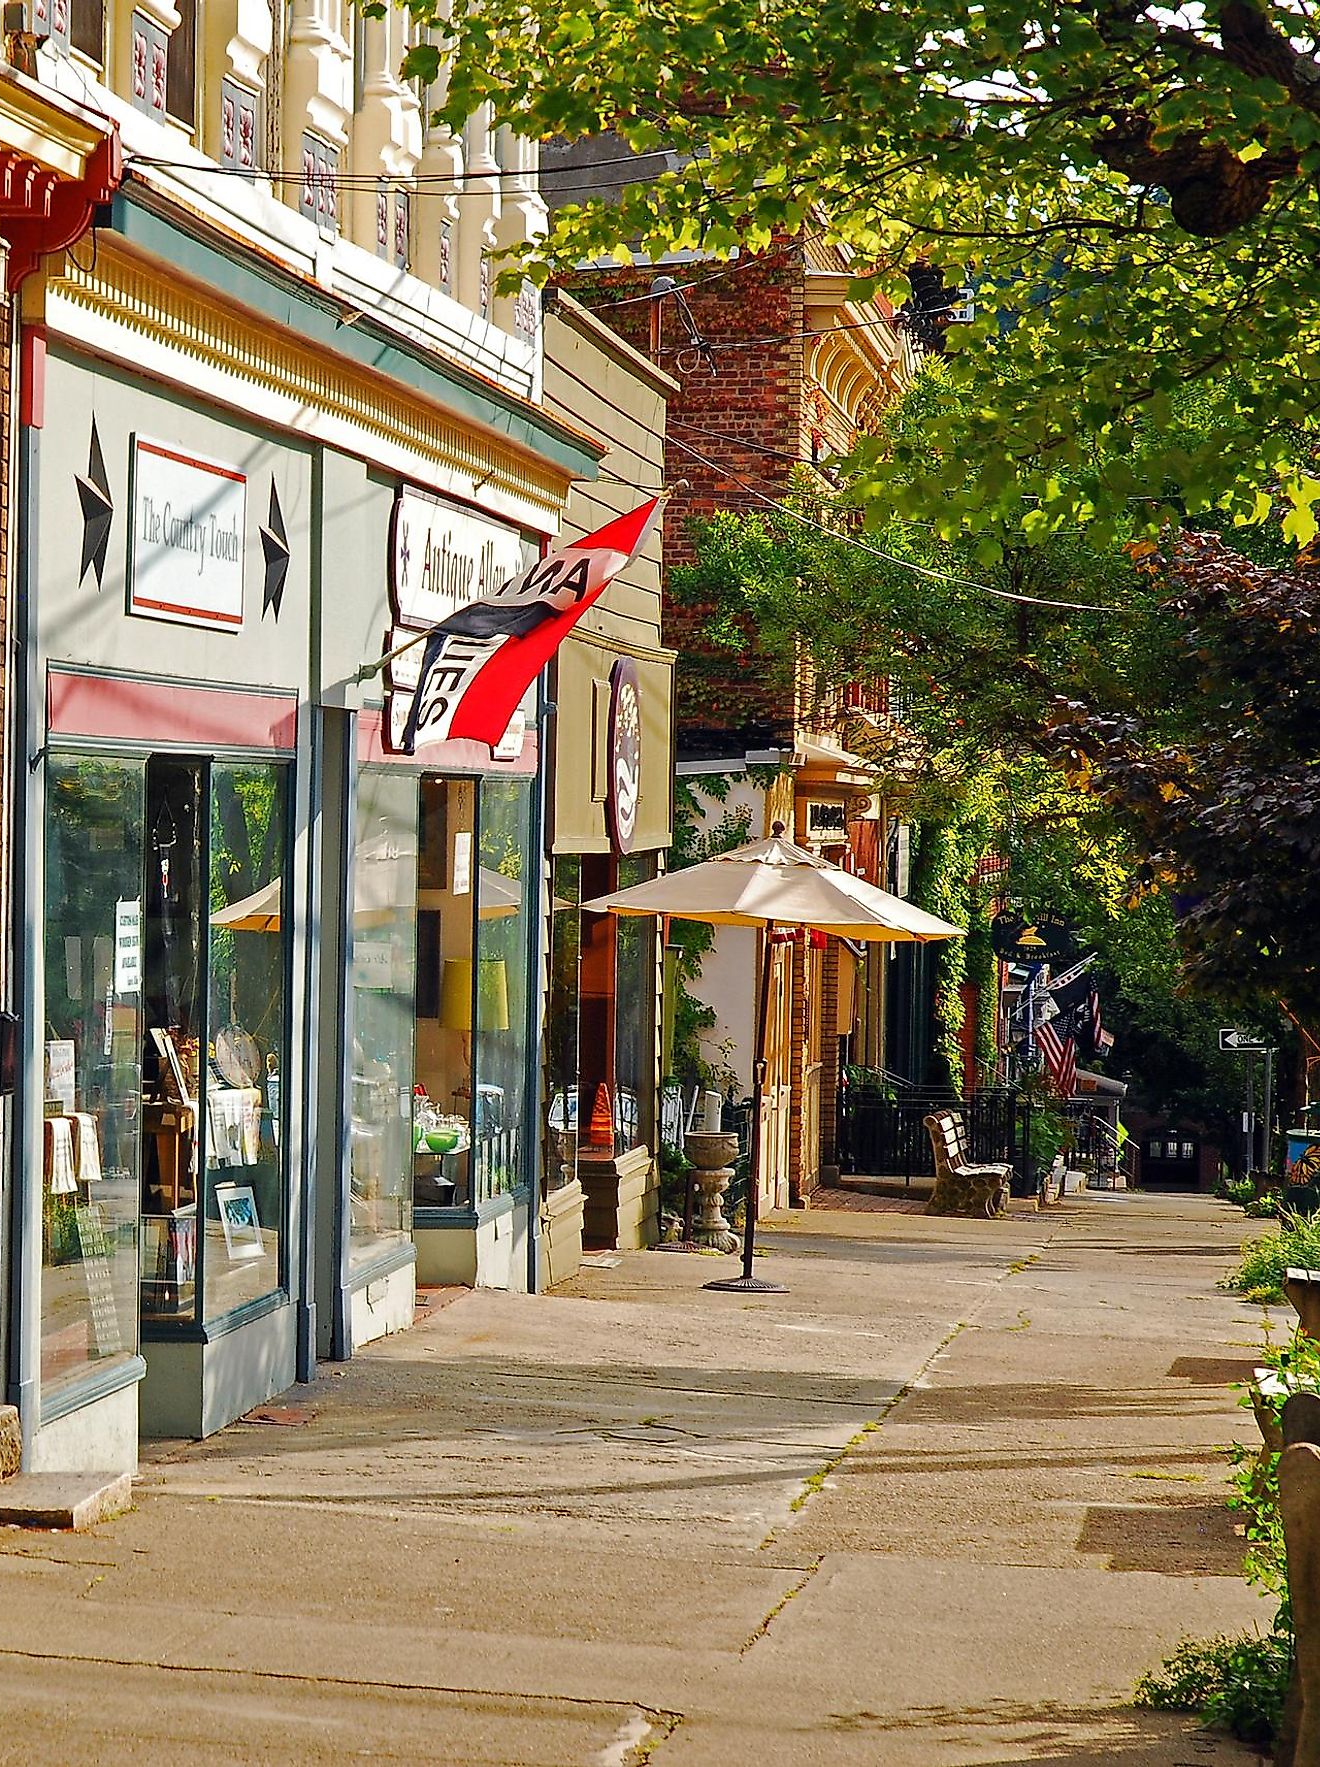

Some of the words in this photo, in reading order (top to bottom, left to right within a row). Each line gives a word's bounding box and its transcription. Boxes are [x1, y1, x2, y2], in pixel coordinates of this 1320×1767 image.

[142, 496, 160, 545] The
[162, 501, 206, 576] Country
[209, 512, 238, 562] Touch
[421, 527, 474, 610] Antique
[997, 914, 1015, 925] The
[1051, 914, 1065, 927] Inn
